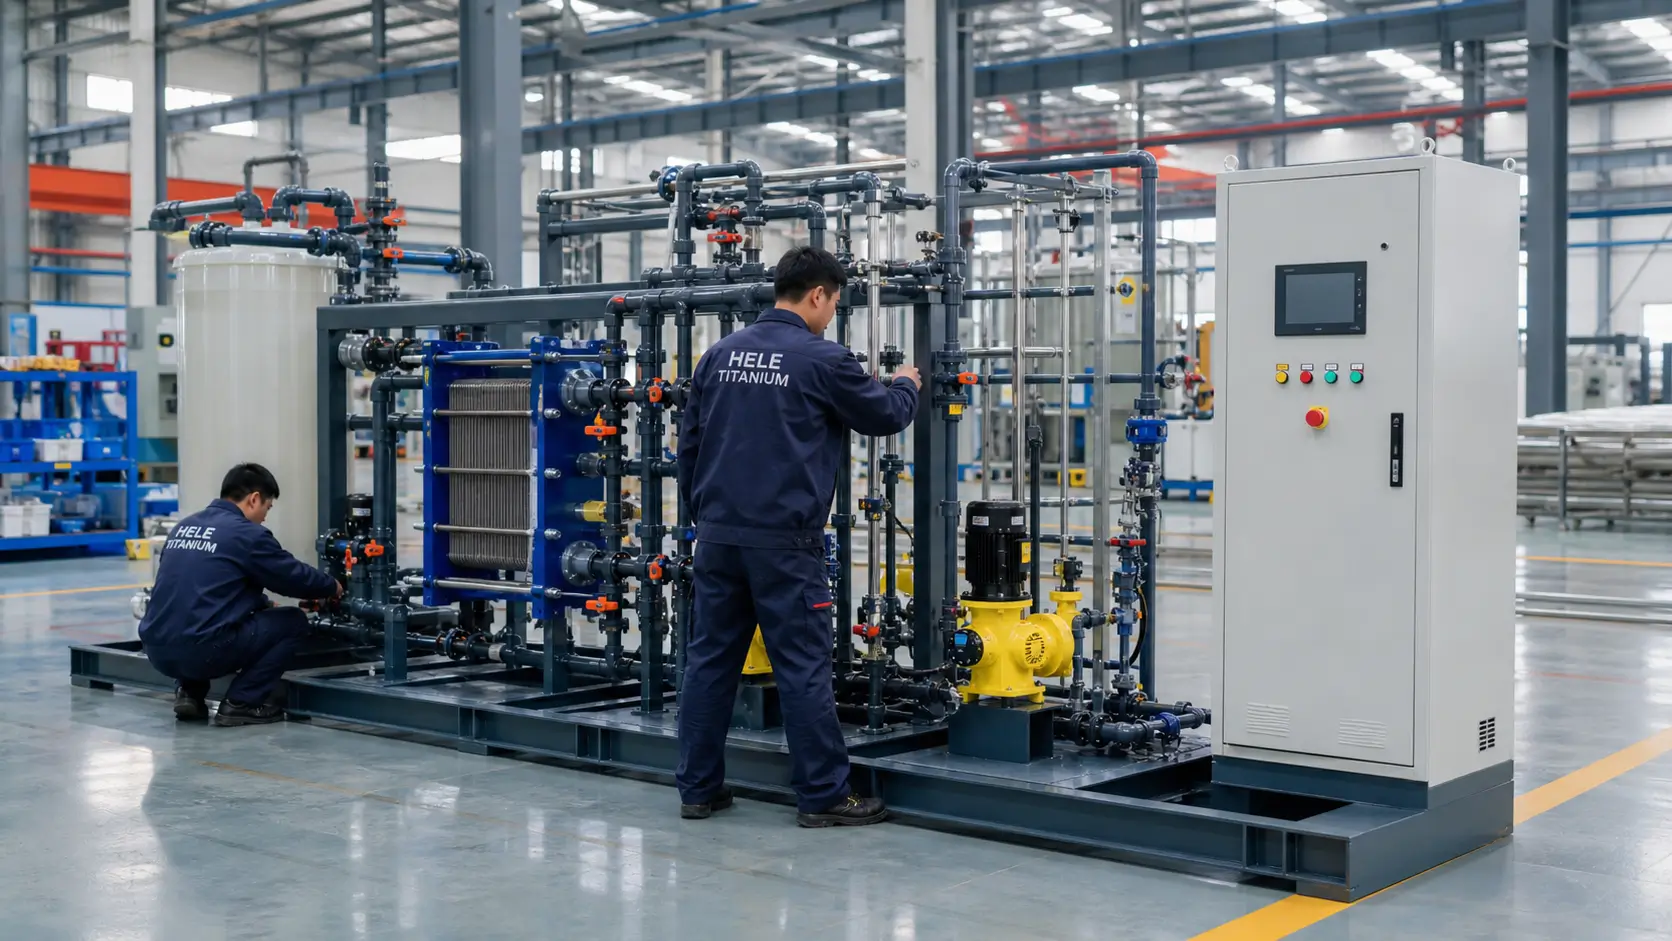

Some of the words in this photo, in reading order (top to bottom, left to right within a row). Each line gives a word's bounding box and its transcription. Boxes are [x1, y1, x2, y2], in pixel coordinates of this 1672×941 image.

[728, 351, 783, 369] HELE
[718, 369, 789, 387] TITANIUM
[175, 525, 216, 539] HELE
[166, 539, 217, 553] TITANIUM
